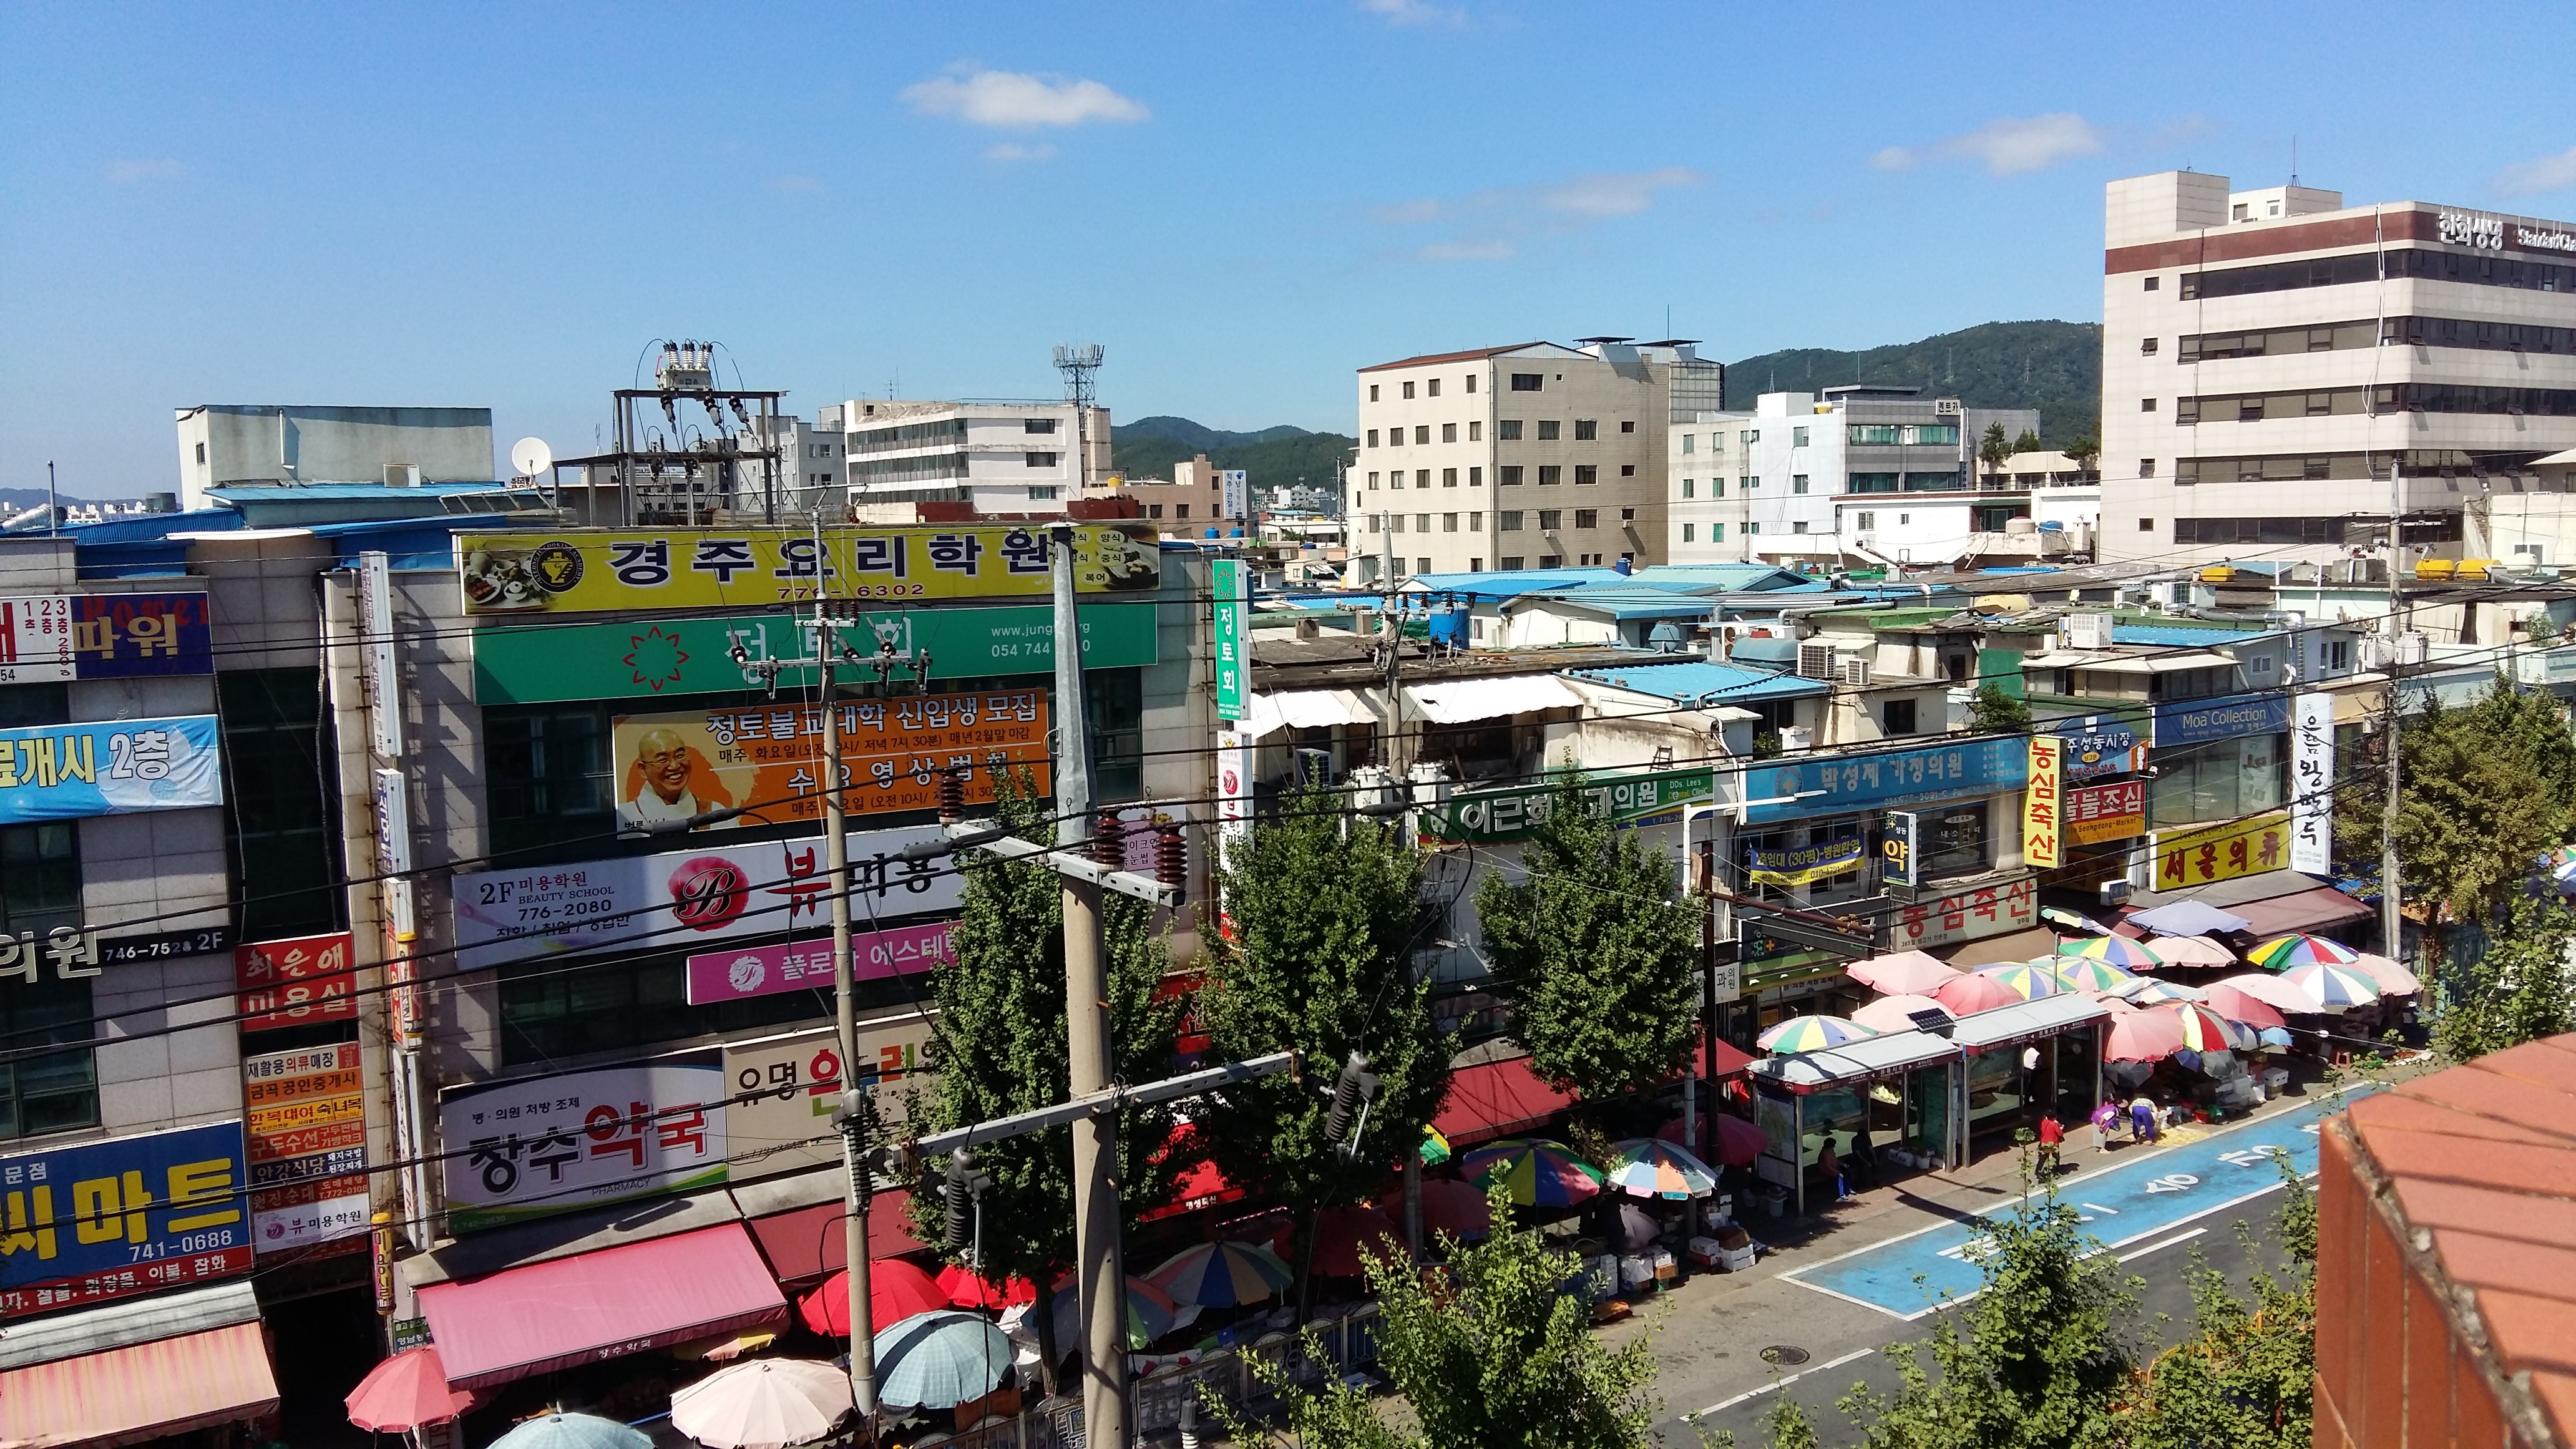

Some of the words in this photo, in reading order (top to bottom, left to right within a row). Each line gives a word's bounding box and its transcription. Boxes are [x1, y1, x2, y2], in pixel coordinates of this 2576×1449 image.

[2439, 212, 2503, 250] 한화생명
[2518, 228, 2559, 250] Standard
[1939, 402, 1958, 412] 렌트카
[1101, 534, 1121, 543] 양식
[612, 528, 1051, 590] 경주요리학원
[1101, 553, 1121, 563] 중식
[1085, 573, 1106, 582] 복어
[41, 600, 52, 635] 2층
[72, 613, 179, 660] 파워
[991, 643, 1018, 657] 054
[1025, 642, 1050, 656] 744
[1221, 606, 1235, 695] 정토회
[0, 669, 16, 681] 54
[706, 701, 886, 746] 정토불교대학
[895, 696, 978, 731] 신입생
[985, 692, 1037, 722] 모집
[2182, 714, 2207, 729] Moa
[2211, 708, 2266, 725] Collection
[108, 730, 170, 781] 2층
[719, 749, 747, 763] 매주
[755, 743, 824, 759] 화요일(오전
[865, 738, 887, 751] 저녁
[891, 736, 909, 749] 7시
[913, 734, 943, 747] 30분)
[949, 731, 972, 745] 매년
[975, 728, 1005, 743] 2월말
[1008, 726, 1030, 741] 마감
[2080, 731, 2131, 752] 성동시장
[1686, 778, 1702, 787] Lee's
[1821, 763, 1880, 794] 박성제
[1890, 751, 1963, 785] 가정의원
[791, 801, 818, 816] 매주
[900, 790, 929, 805] 10시/
[1585, 780, 1659, 819] 과의원
[1668, 791, 1690, 800] Dental
[2028, 740, 2056, 862] 농심축산
[2300, 759, 2324, 846] 왕만두
[1659, 814, 1684, 824] 776-28
[1895, 826, 1907, 835] 성동
[2078, 817, 2137, 832] Seongdong-Market
[1883, 839, 1908, 872] 약
[2164, 830, 2281, 884] 서울의류
[480, 882, 515, 905] 2F
[518, 871, 587, 894] 미용학원
[519, 892, 565, 904] BEAUTY
[569, 886, 615, 899] SCHOOL
[766, 846, 832, 918] 뷰
[518, 899, 612, 921] 776-2080
[0, 925, 102, 984] 의원
[105, 941, 192, 962] 746-7528
[197, 932, 223, 951] 2F
[245, 941, 344, 979] 최은애
[781, 945, 860, 982] 플로
[248, 980, 348, 1022] 미용실
[247, 1051, 334, 1079] 재활용의류매장
[250, 1083, 279, 1100] 금곡
[283, 1071, 356, 1095] 공인중개사
[734, 1060, 797, 1108] 유명
[248, 1106, 315, 1126] 한복대여
[316, 1098, 363, 1114] 숙녀복
[472, 1105, 521, 1125] 병·의원
[525, 1101, 552, 1115] 처방
[555, 1096, 580, 1111] 조제
[251, 1131, 319, 1158] 구두수선
[320, 1121, 361, 1135] 구두판매
[469, 1098, 707, 1194] 장수약국
[4, 1161, 48, 1185] 문점
[256, 1156, 325, 1183] 안강식당
[327, 1148, 363, 1162] 돼지국밥
[328, 1159, 363, 1174] 된장찌개
[252, 1184, 315, 1210] 원진순대
[318, 1184, 368, 1200] T.772-0108
[592, 1177, 652, 1198] PHARMACY
[0, 1158, 241, 1261] 씨마트
[1186, 1195, 1217, 1211] 명성축산
[288, 1217, 306, 1236] 뷰
[308, 1209, 362, 1230] 미용학원
[129, 1229, 233, 1262] 741-0688
[149, 1262, 187, 1284] 이불.
[194, 1254, 227, 1276] 잡화
[598, 1339, 651, 1359] 장수약국
